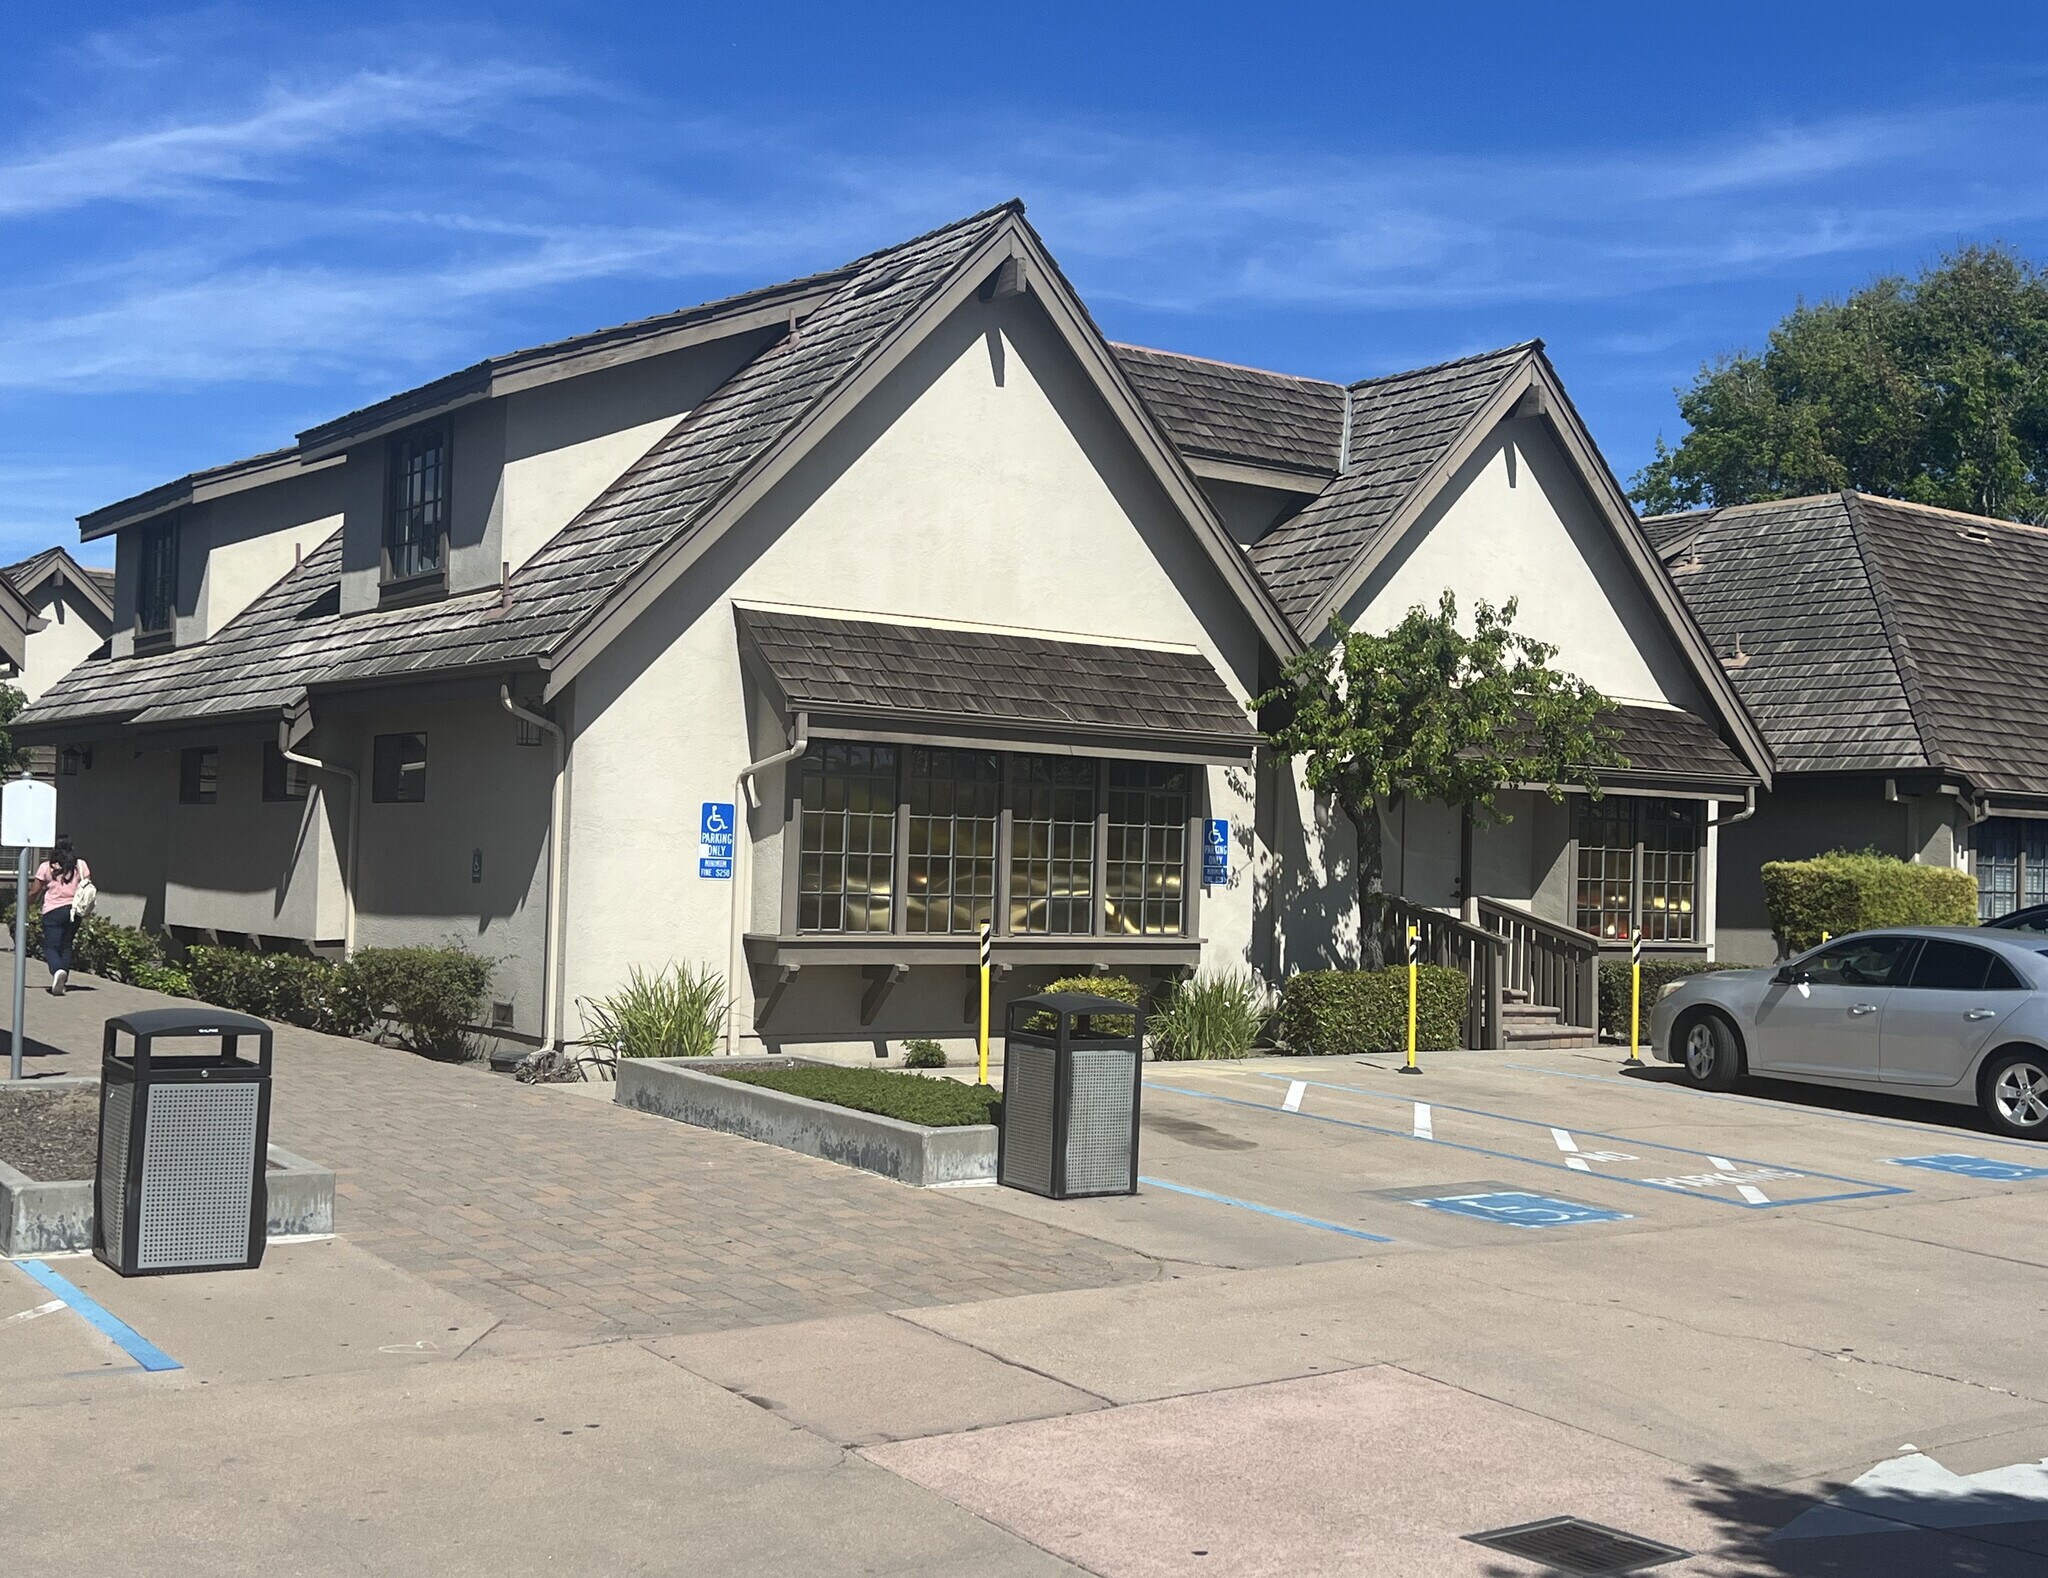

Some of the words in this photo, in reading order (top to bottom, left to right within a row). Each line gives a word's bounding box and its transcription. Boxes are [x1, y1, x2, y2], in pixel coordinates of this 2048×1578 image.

[701, 832, 733, 844] PARKING
[708, 845, 726, 856] ONLY
[1204, 845, 1228, 855] PARKING
[1208, 856, 1223, 865] ONLY
[715, 869, 730, 878] $250
[1568, 1151, 1641, 1162] NO
[1642, 1168, 1805, 1188] PARKING
